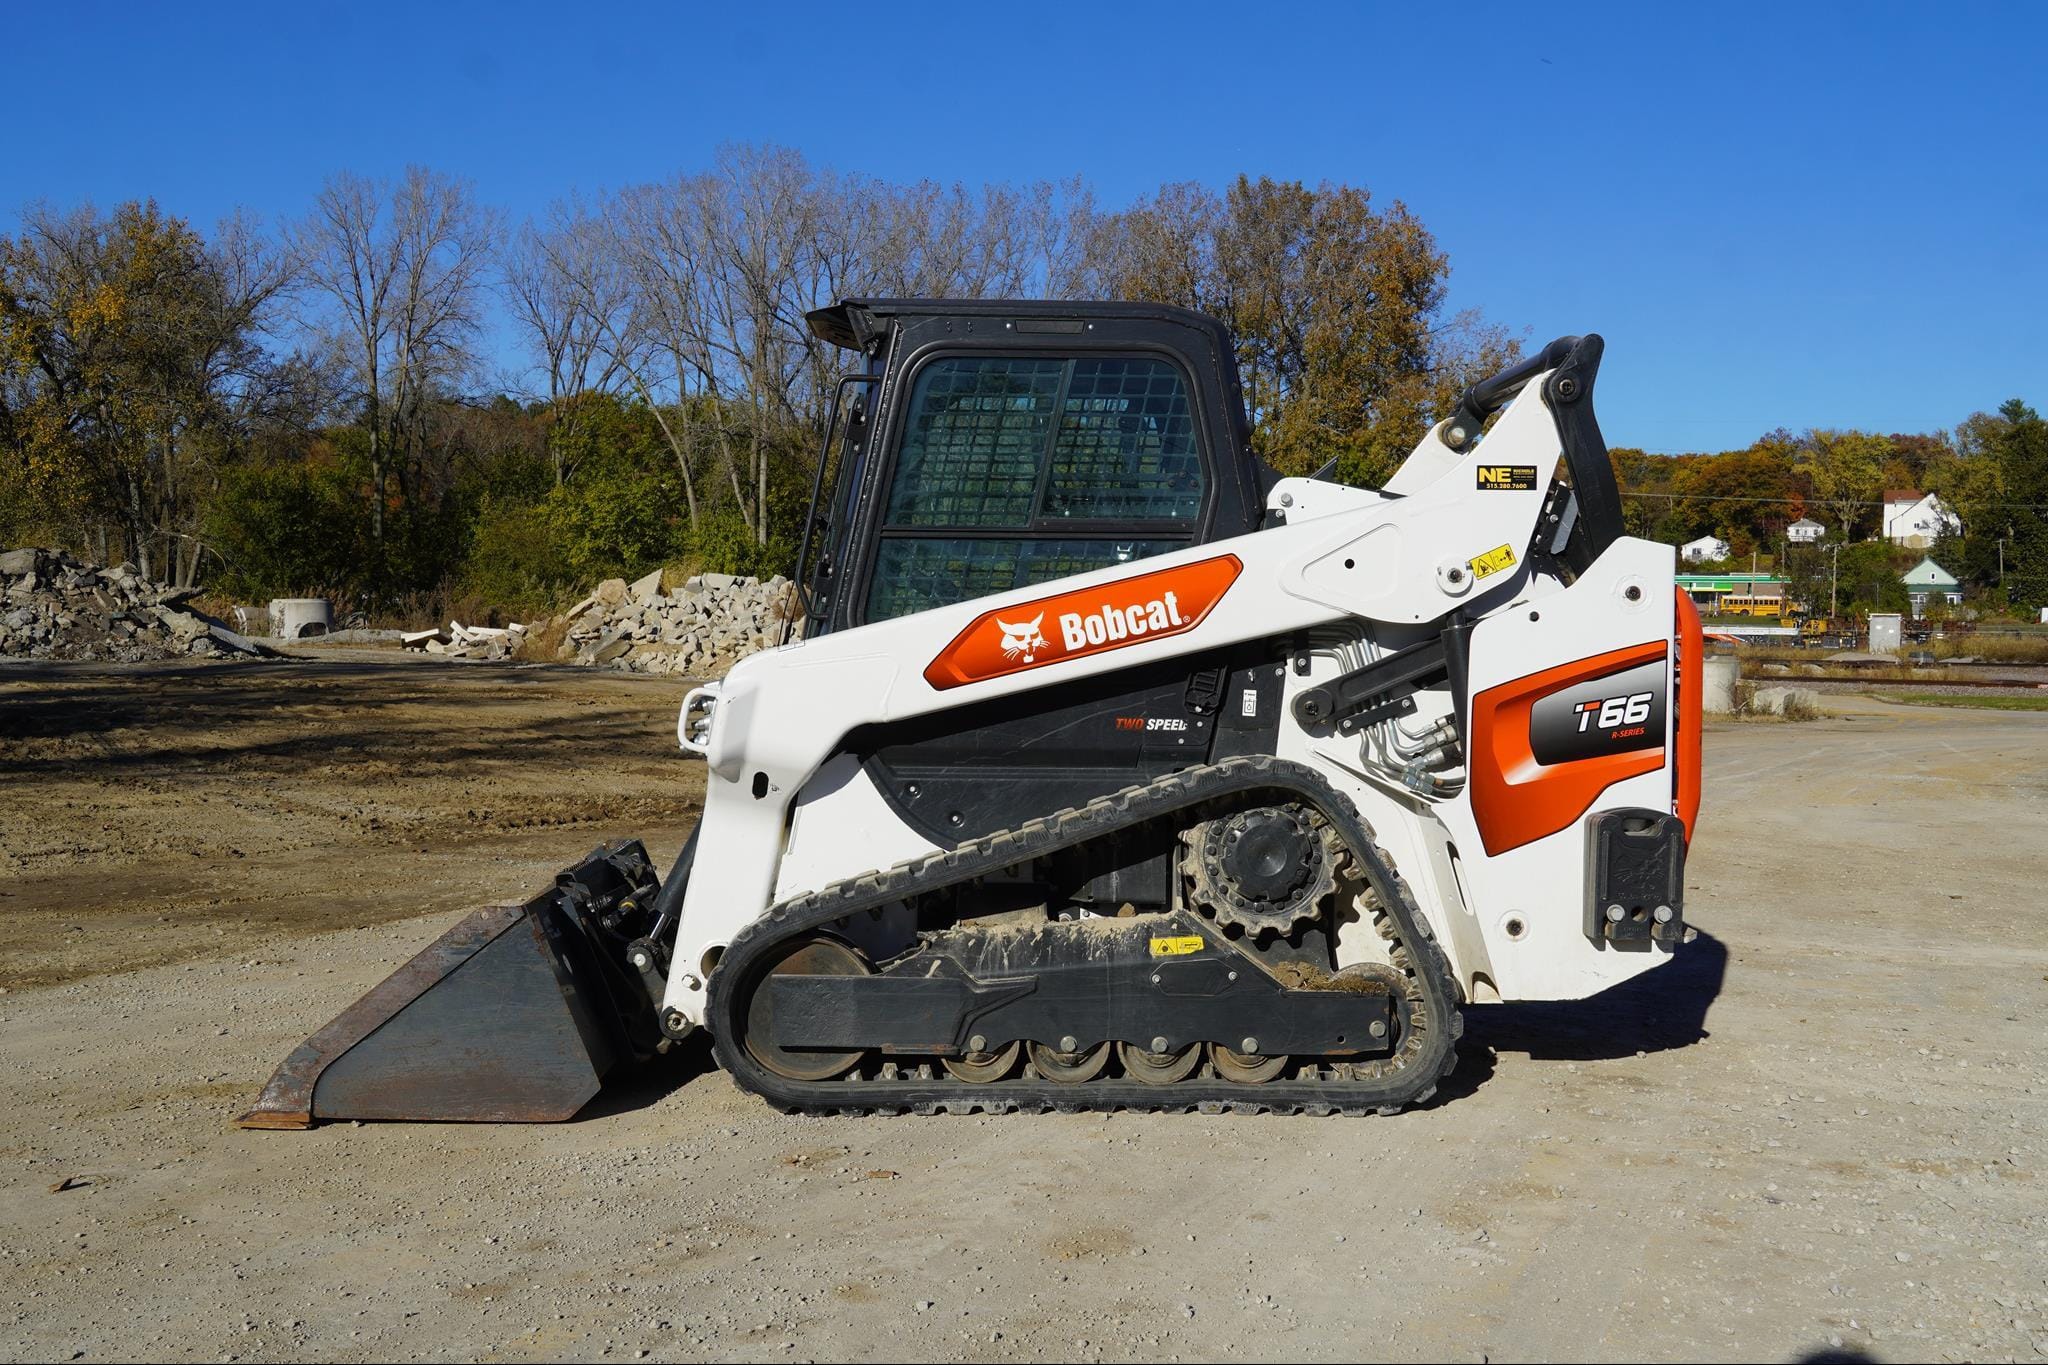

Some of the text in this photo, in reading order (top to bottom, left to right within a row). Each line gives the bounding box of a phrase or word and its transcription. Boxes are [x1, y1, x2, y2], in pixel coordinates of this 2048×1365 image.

[1479, 468, 1511, 482] NE
[1059, 591, 1182, 651] Bobcat
[1575, 693, 1653, 732] T66
[1115, 718, 1144, 729] TWO
[1611, 727, 1645, 739] R-SERIES
